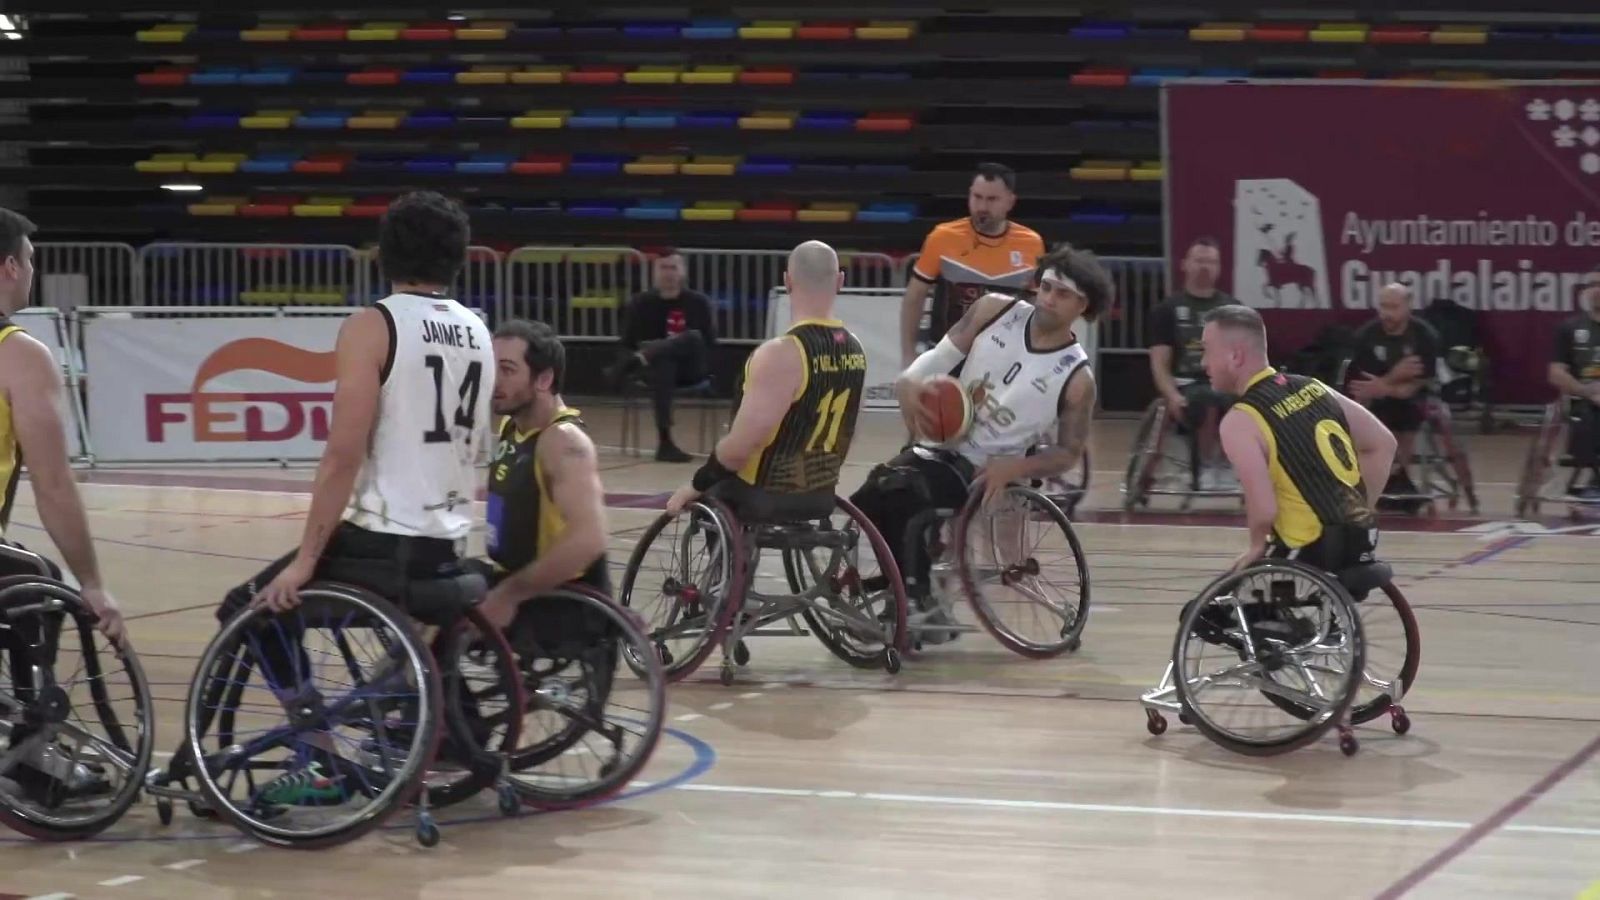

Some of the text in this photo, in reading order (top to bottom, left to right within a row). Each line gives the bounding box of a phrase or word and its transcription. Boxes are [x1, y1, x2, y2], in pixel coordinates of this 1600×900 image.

[1340, 210, 1600, 253] Ayuntamiento de
[422, 319, 481, 350] JAIME E.
[423, 354, 482, 444] 14
[1003, 361, 1022, 386] 0
[805, 387, 851, 453] 11
[1315, 419, 1361, 488] 0
